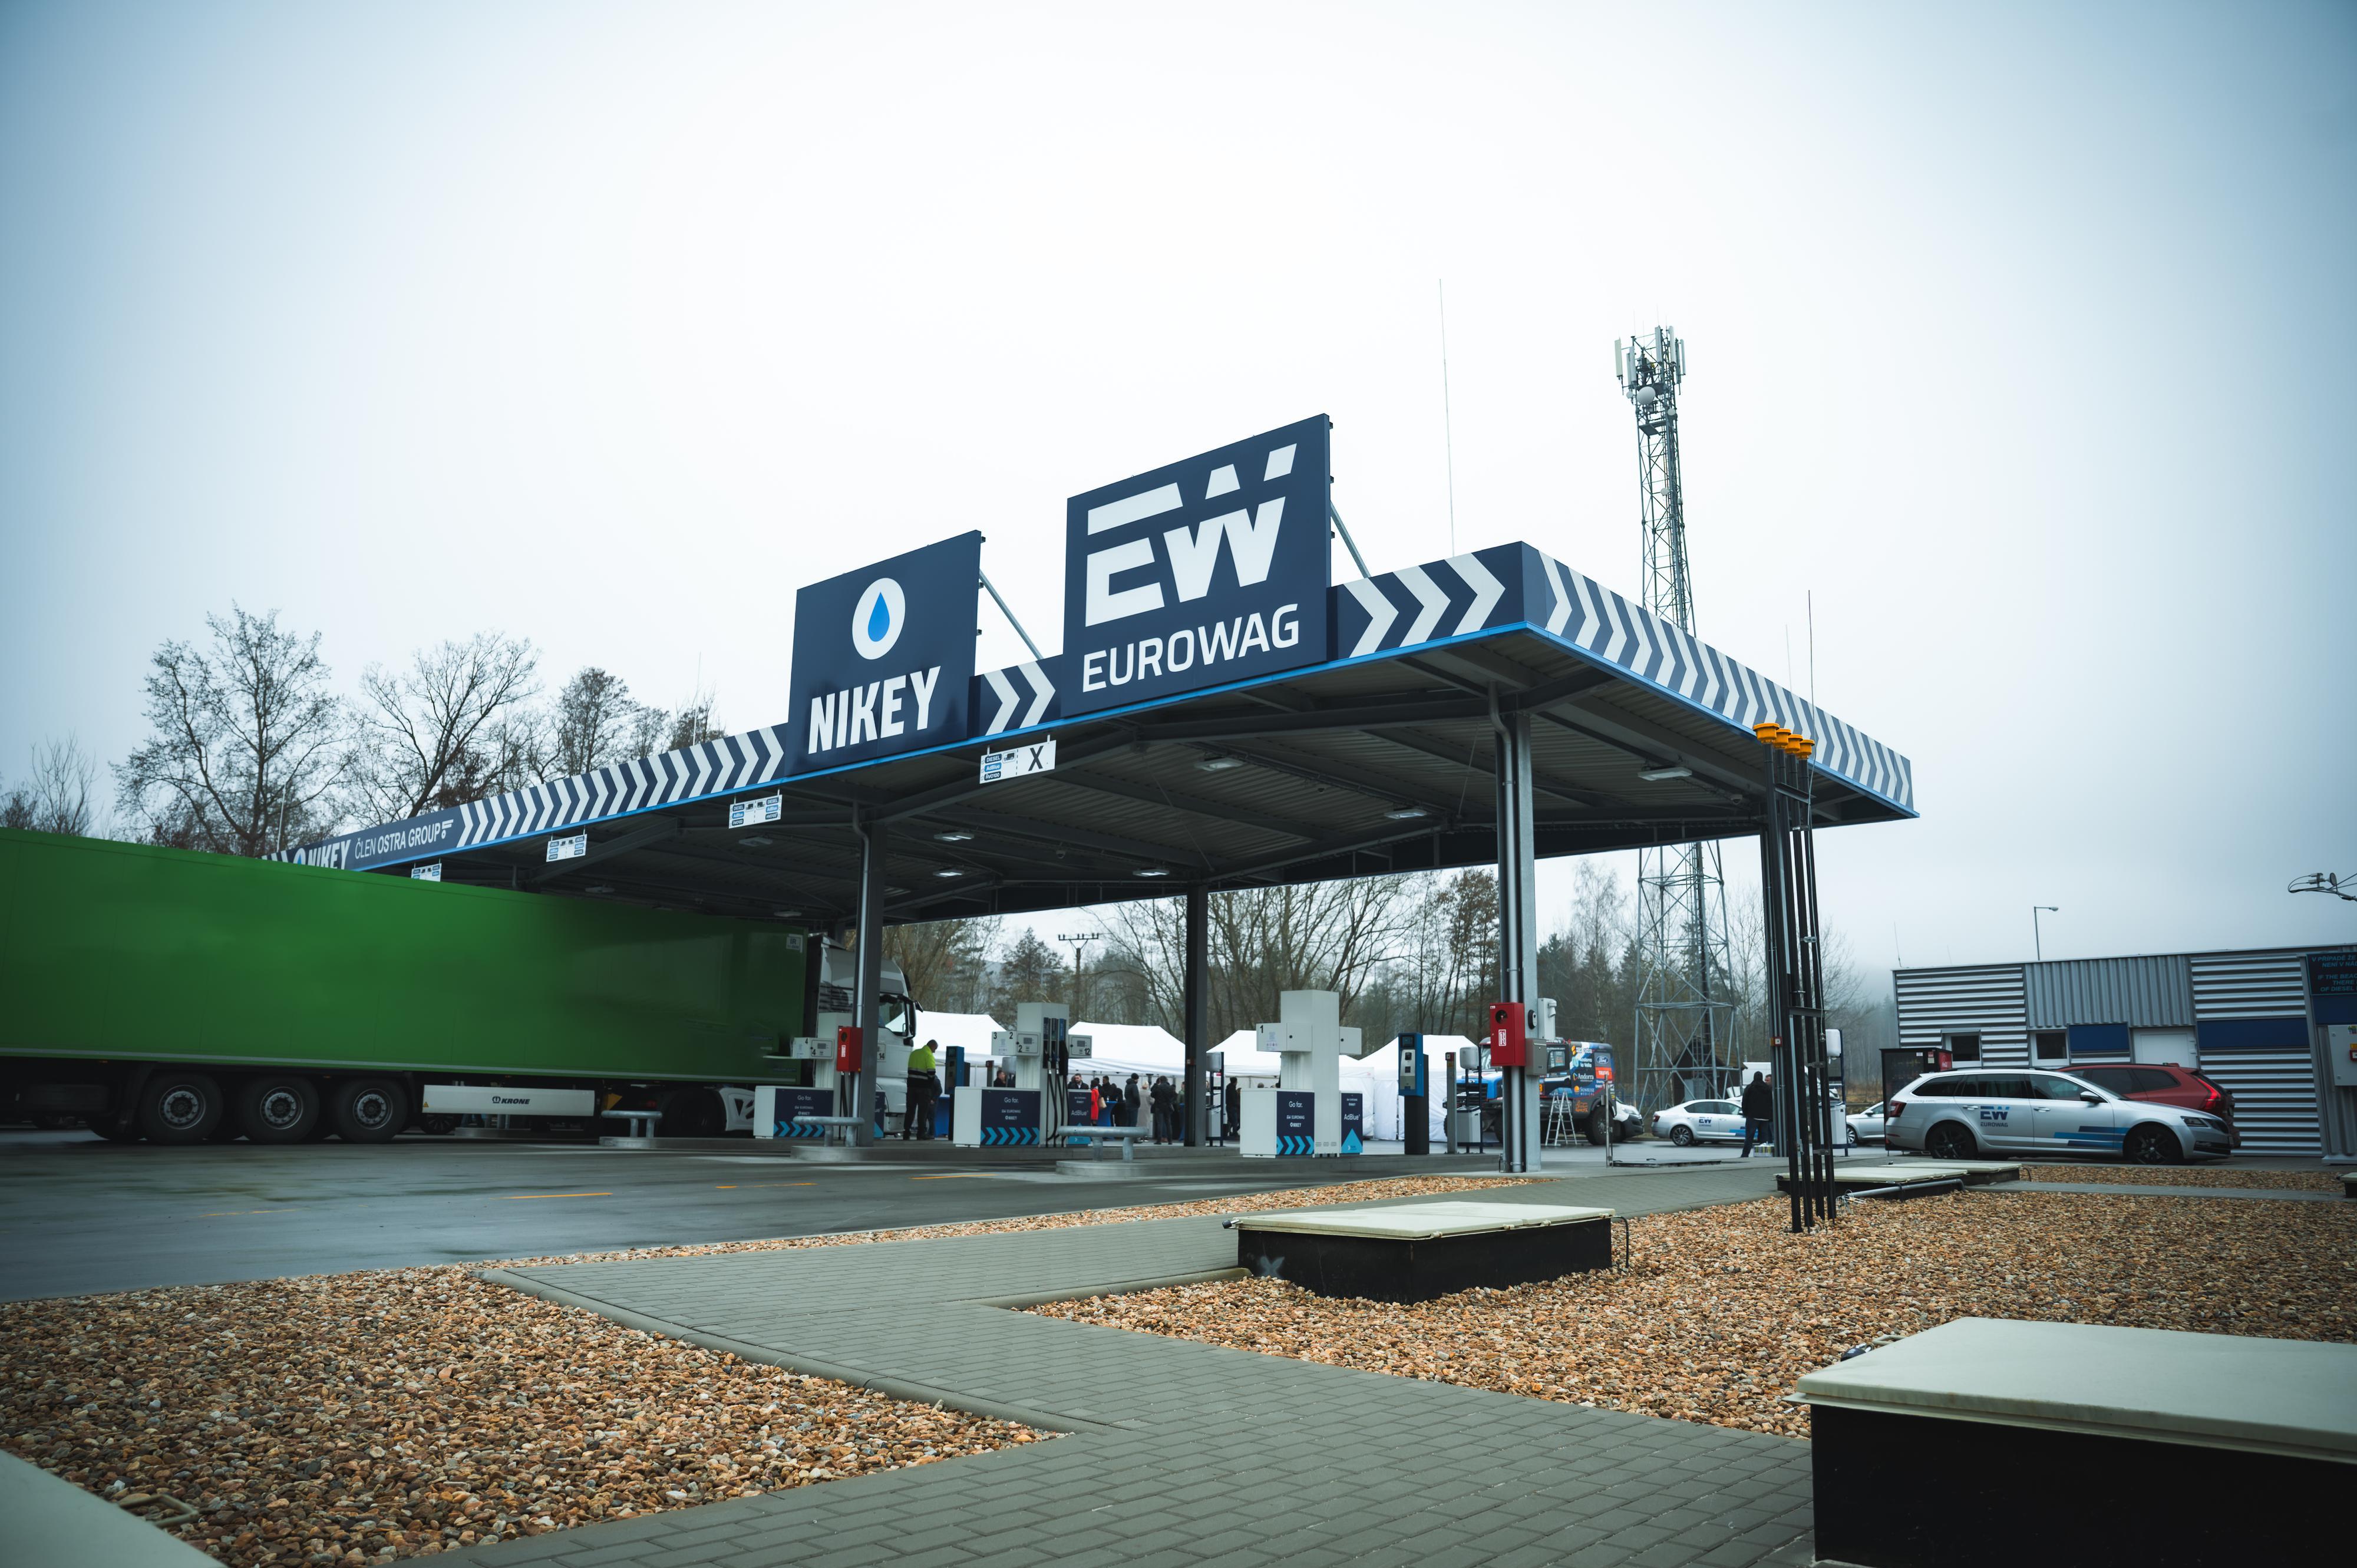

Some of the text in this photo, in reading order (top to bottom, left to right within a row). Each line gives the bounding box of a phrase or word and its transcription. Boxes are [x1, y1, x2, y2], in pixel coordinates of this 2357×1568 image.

[1082, 603, 1299, 692] EUROWAG
[808, 666, 941, 754] NIKEY
[1028, 745, 1044, 771] X
[307, 840, 351, 870] NIKEY
[355, 823, 441, 859] ČLEN OSTRA GROUP
[1260, 1025, 1263, 1034] 1
[1084, 1048, 1090, 1056] 12
